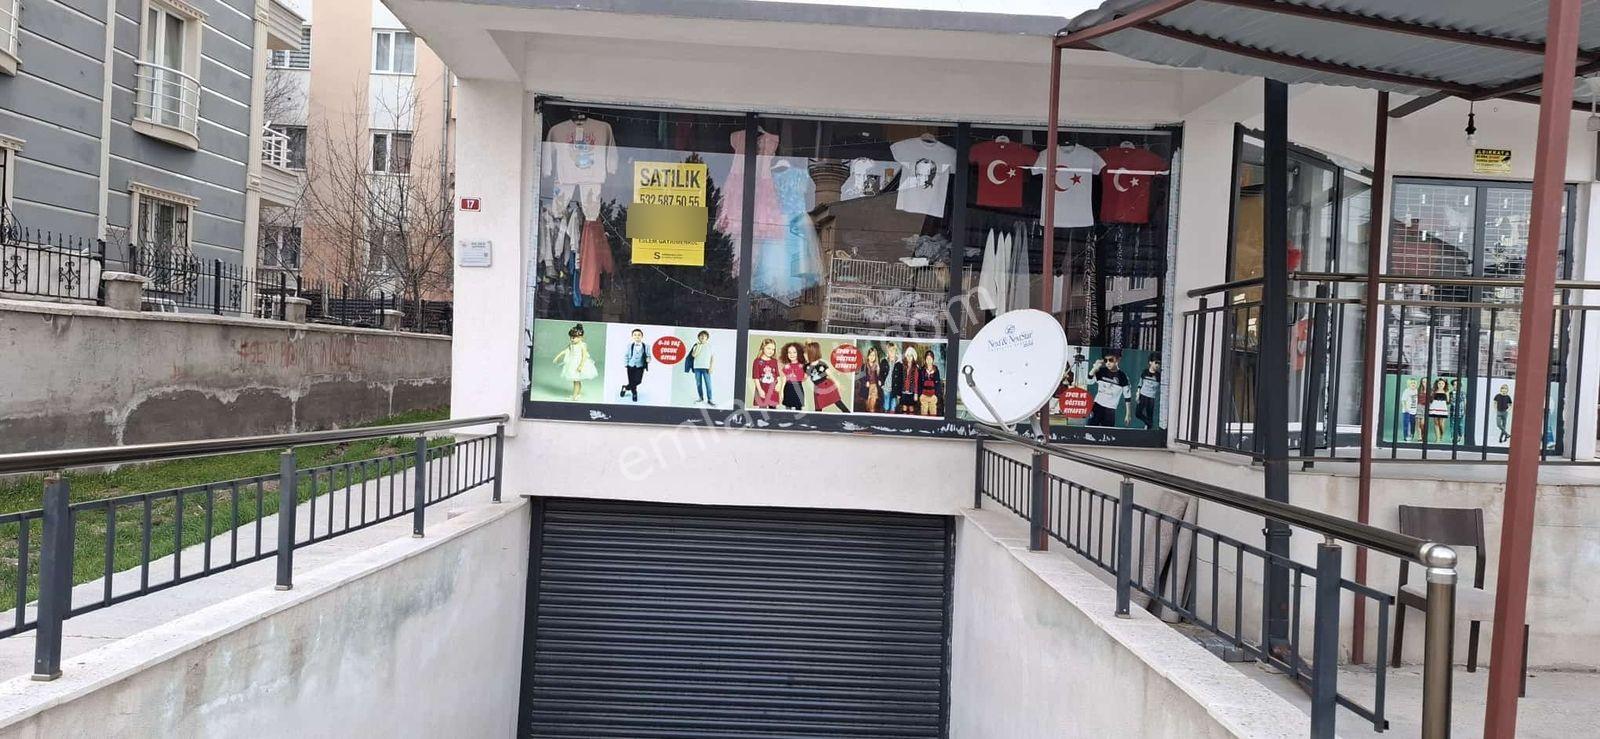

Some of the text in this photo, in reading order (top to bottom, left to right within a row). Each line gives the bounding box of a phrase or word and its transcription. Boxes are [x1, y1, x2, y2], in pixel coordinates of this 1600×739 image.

[640, 168, 700, 188] SATILIK
[466, 199, 475, 209] 17
[640, 193, 656, 205] 532
[658, 194, 674, 206] 587
[675, 195, 687, 207] 50
[1065, 391, 1079, 399] SPOR
